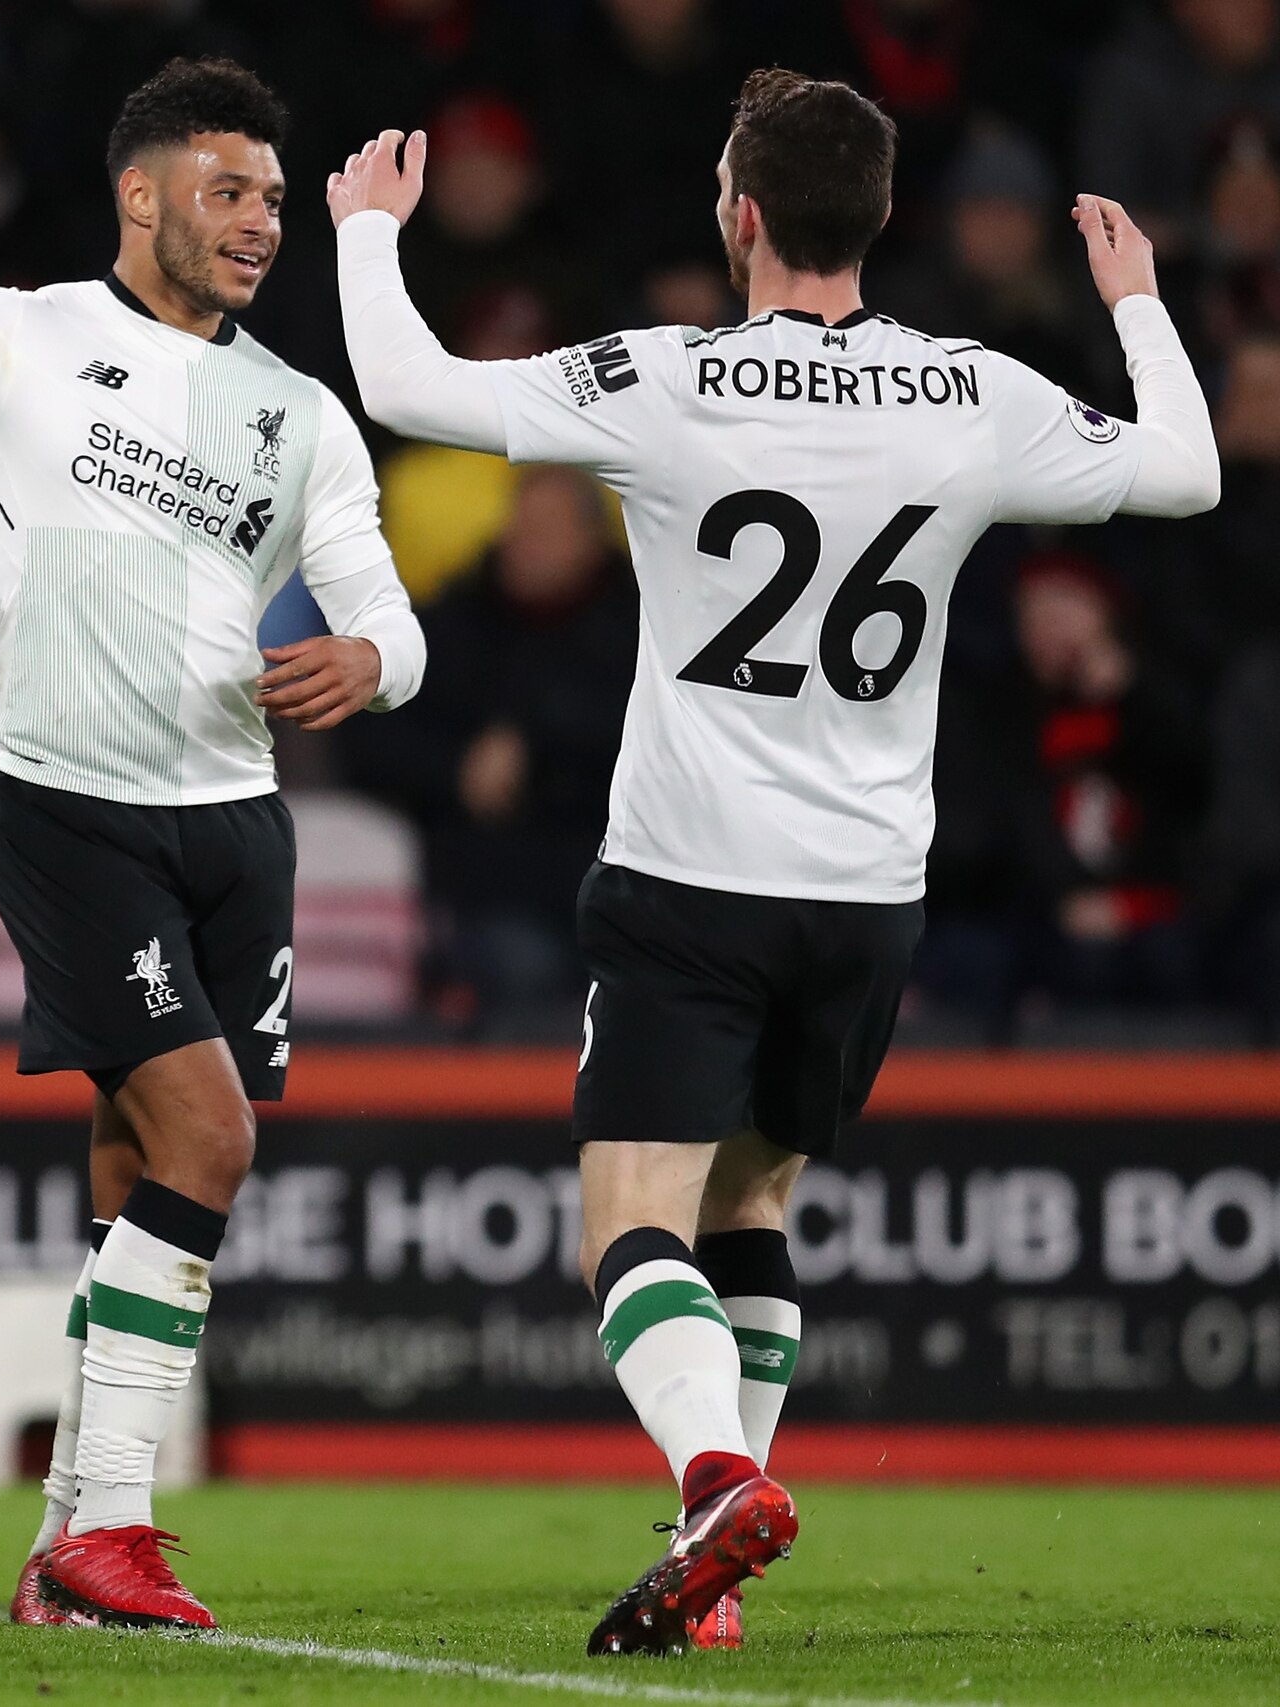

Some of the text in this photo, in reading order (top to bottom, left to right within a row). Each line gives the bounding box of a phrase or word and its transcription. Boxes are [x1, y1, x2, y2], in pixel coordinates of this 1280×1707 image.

[558, 355, 589, 408] UNION
[698, 357, 980, 406] ROBERTSON
[71, 454, 230, 538] Chartered
[88, 421, 240, 506] Standard
[675, 489, 940, 704] 26
[783, 1165, 1082, 1284] CLUB
